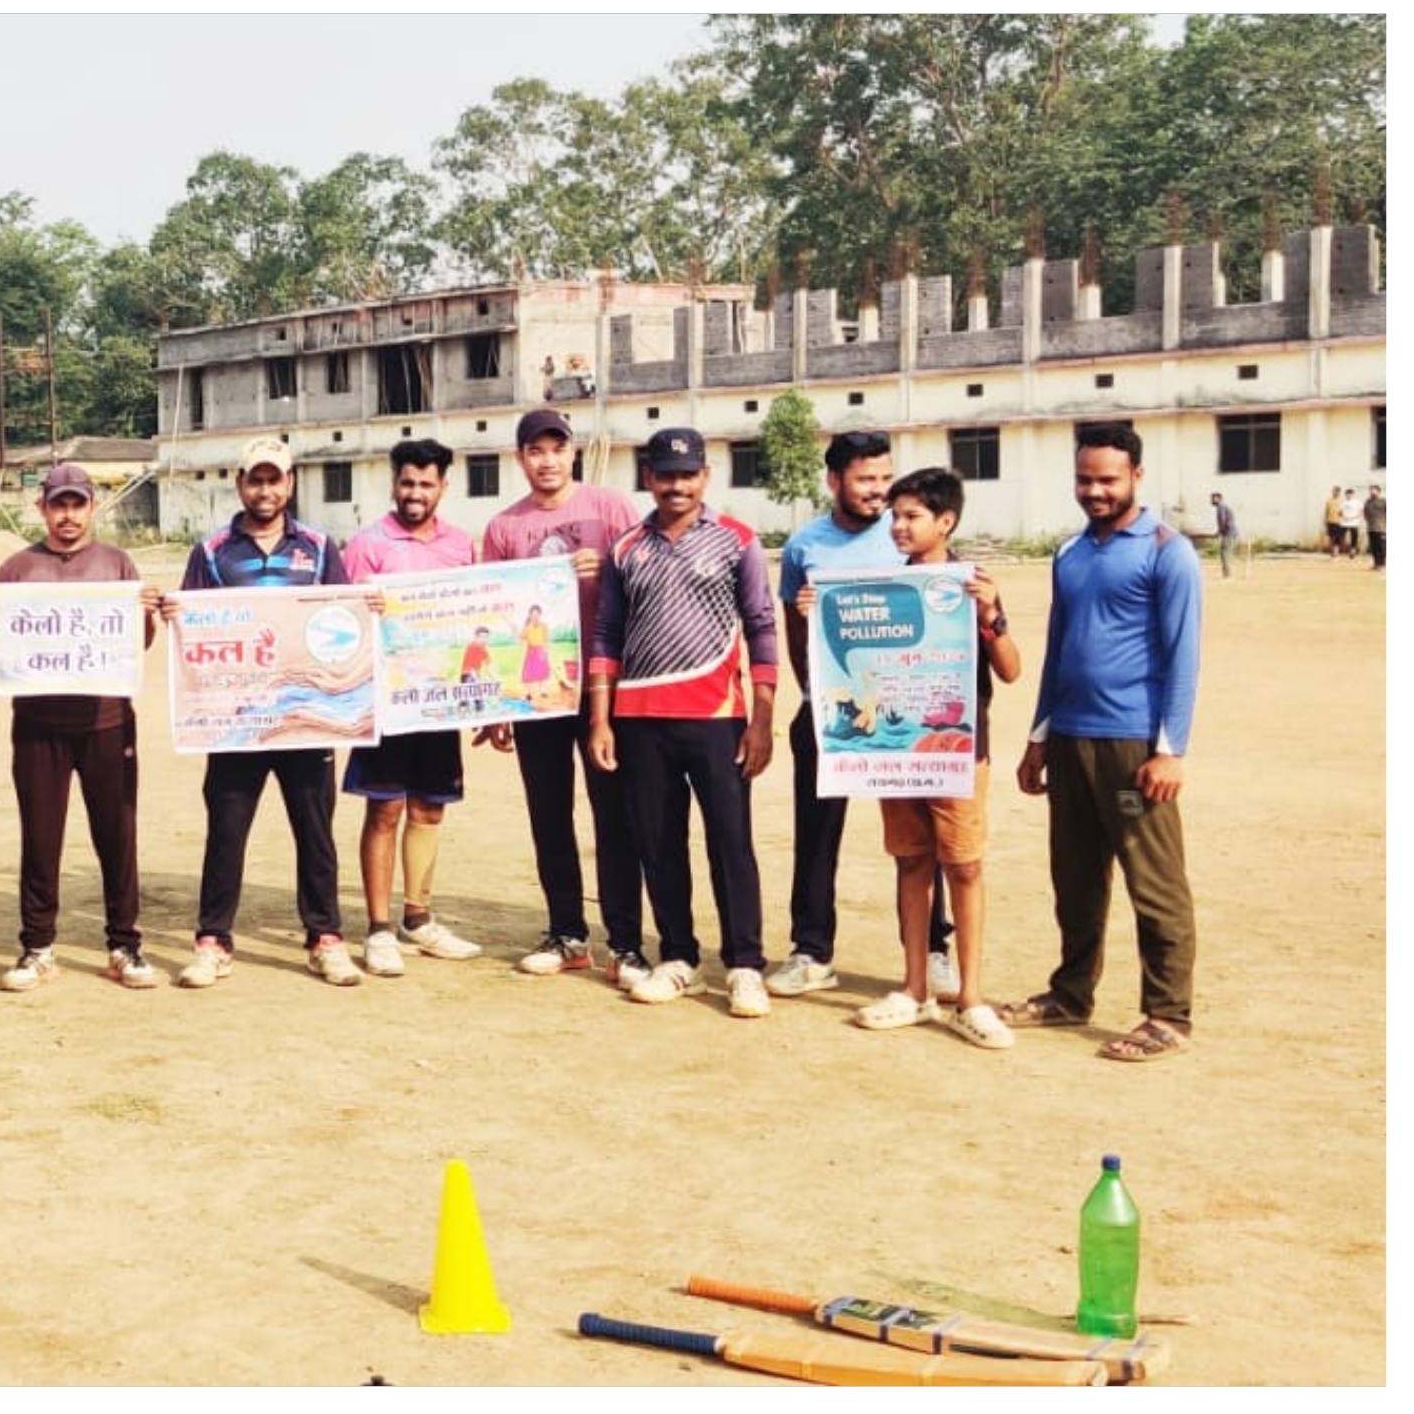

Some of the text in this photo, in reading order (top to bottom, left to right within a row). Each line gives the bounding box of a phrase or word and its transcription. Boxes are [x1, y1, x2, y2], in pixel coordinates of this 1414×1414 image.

[10, 608, 61, 635] केलो
[100, 608, 124, 635] तो
[838, 607, 891, 623] WATER
[840, 624, 914, 640] POLLUTION
[186, 628, 275, 667] कल है
[28, 651, 70, 671] कल
